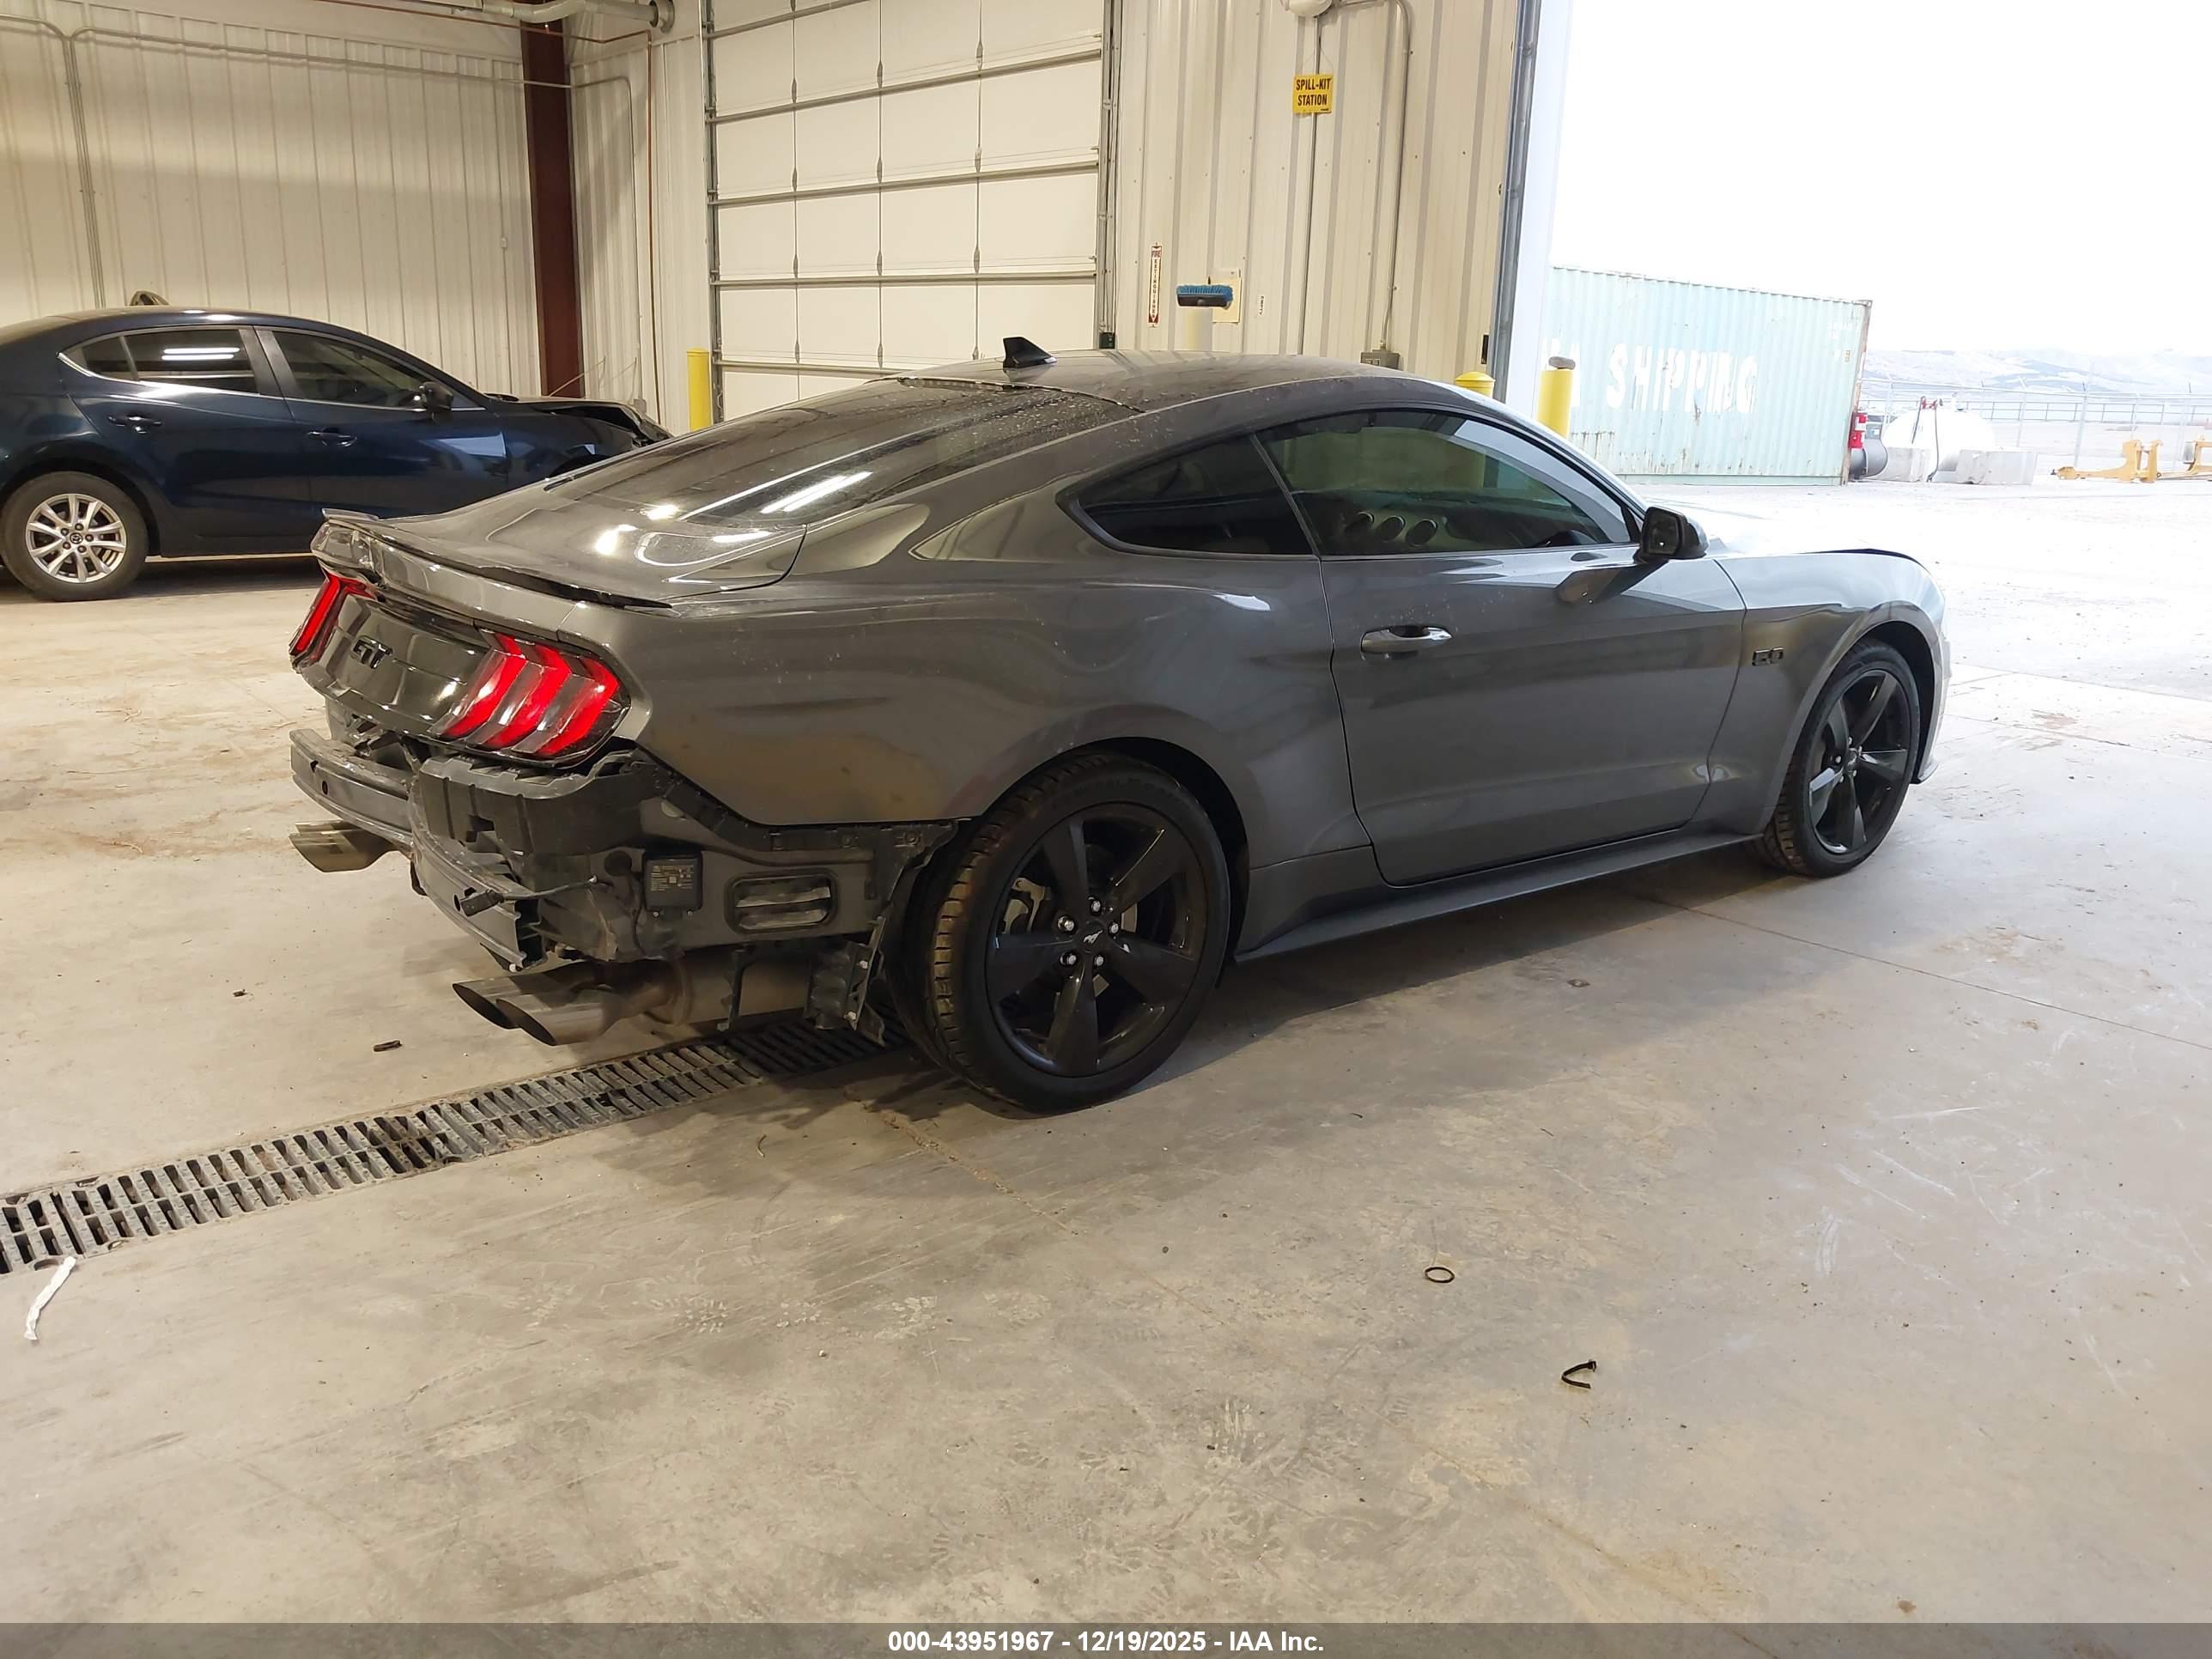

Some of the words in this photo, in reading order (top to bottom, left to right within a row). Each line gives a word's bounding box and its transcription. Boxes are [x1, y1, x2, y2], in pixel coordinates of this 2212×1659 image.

[1296, 78, 1332, 91] SPILL-KIT
[1297, 94, 1328, 106] STATION
[353, 635, 393, 669] GT
